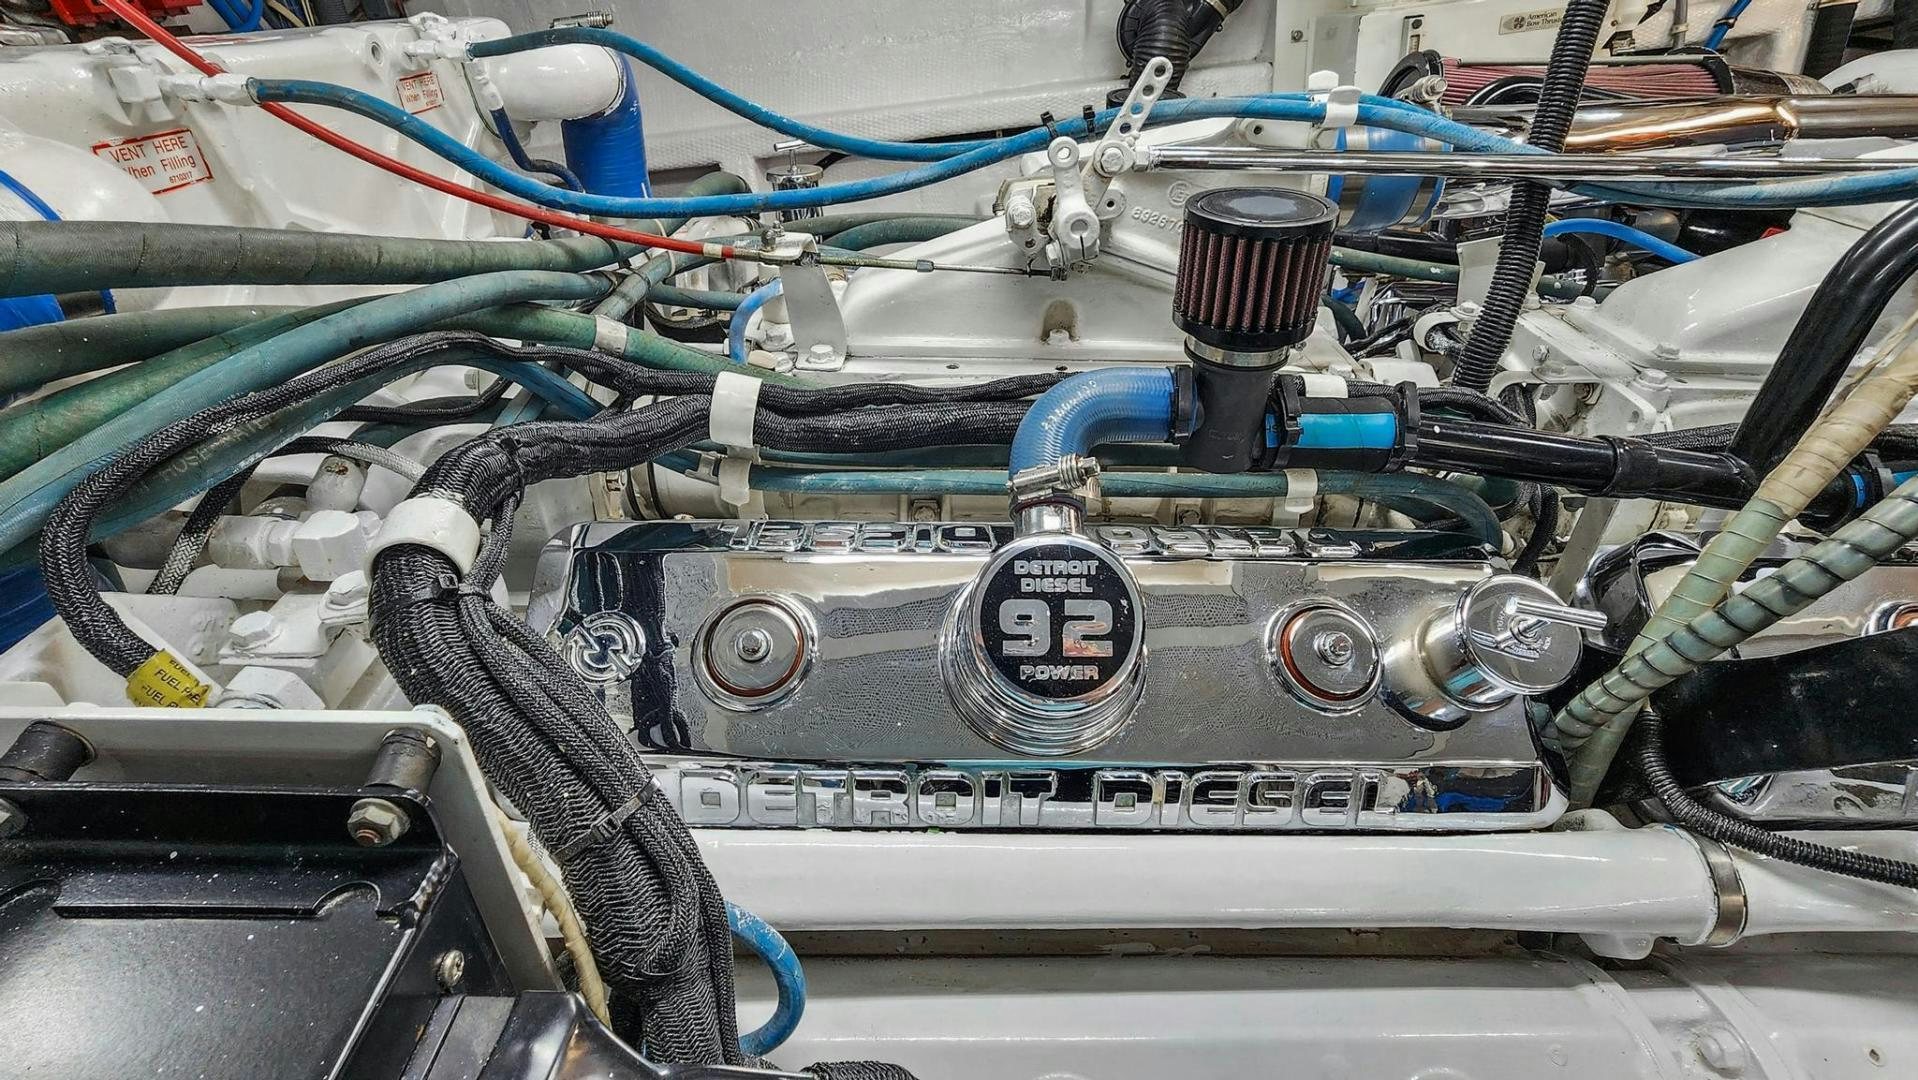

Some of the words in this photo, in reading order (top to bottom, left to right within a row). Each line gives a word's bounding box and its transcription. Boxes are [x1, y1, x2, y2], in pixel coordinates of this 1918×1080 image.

[1527, 12, 1557, 20] American
[108, 143, 147, 163] VENT
[152, 136, 189, 154] HERE
[160, 154, 197, 172] Filling
[1014, 560, 1099, 575] DETROIT
[1020, 578, 1093, 593] DIESEL
[999, 599, 1113, 657] 92
[154, 669, 180, 691] FUEL
[1020, 665, 1099, 681] POWER
[142, 684, 166, 706] FUEL
[679, 769, 1058, 826] DETROIT
[1092, 769, 1398, 827] DIESEL
